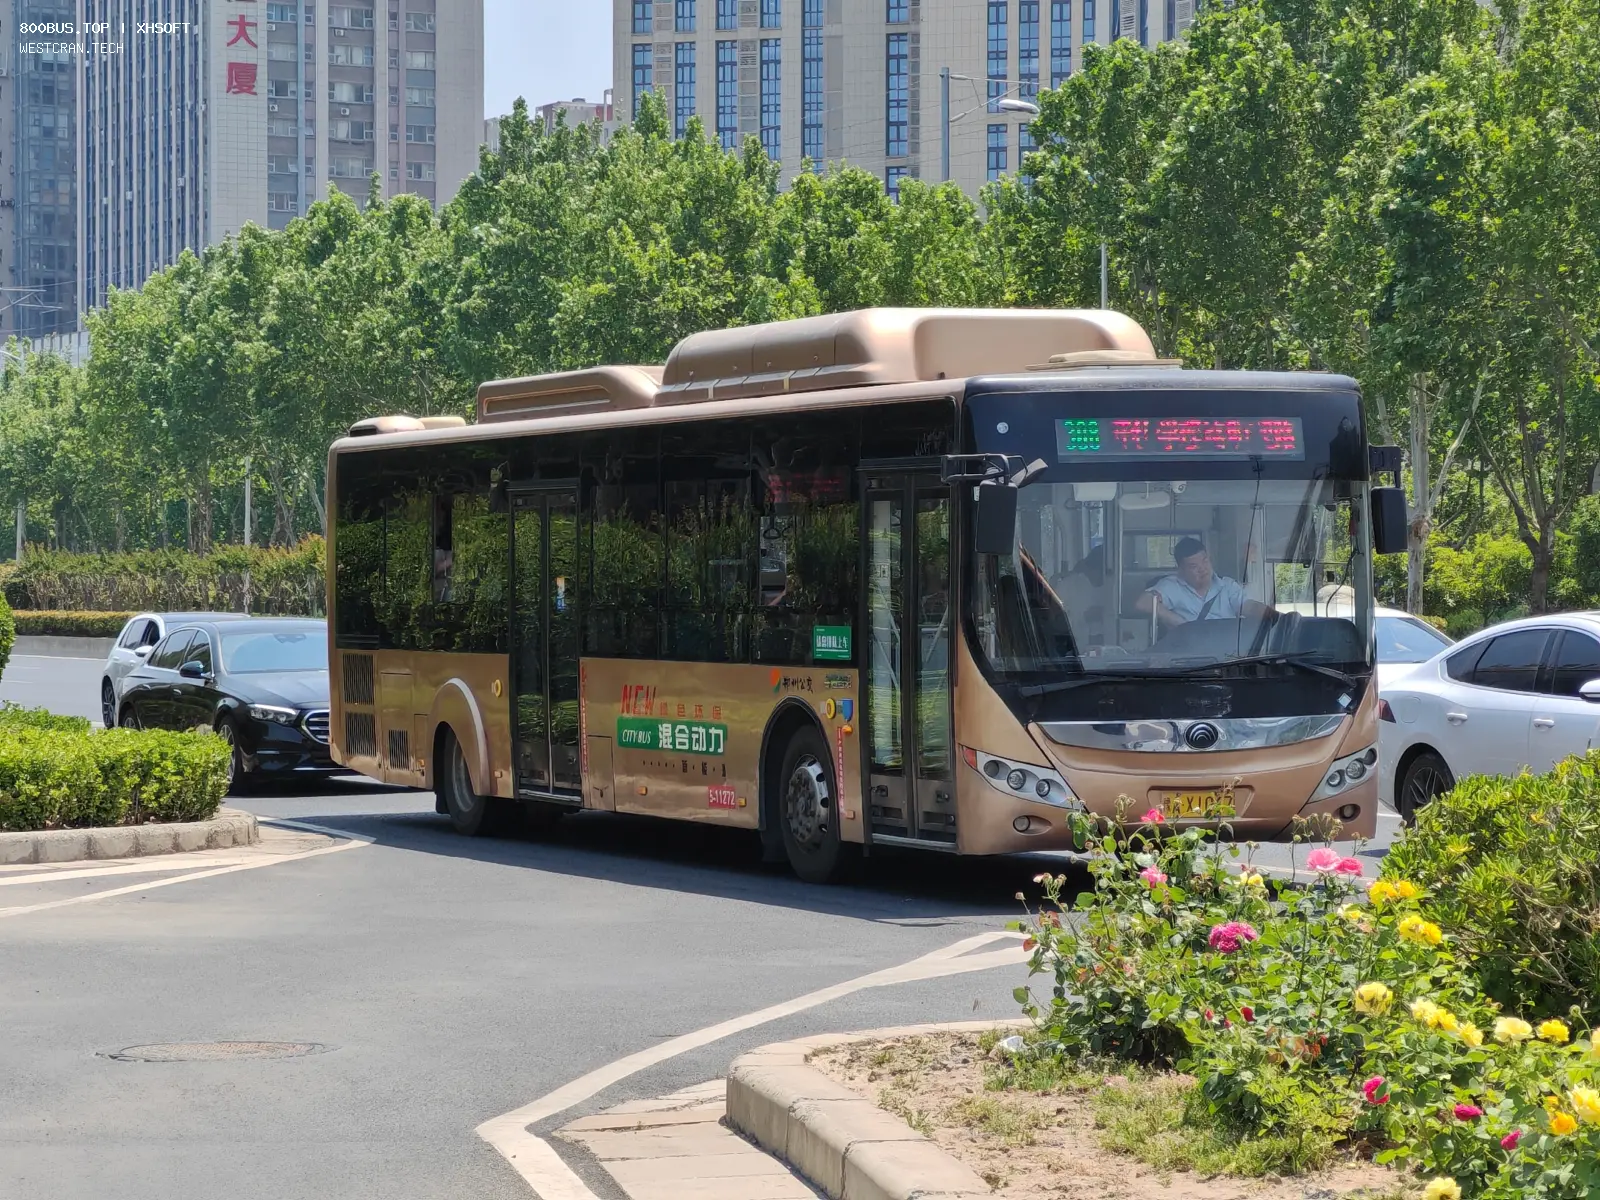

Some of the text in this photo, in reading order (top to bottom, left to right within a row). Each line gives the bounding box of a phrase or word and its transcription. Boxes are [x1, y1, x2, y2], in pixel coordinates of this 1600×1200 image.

[226, 0, 258, 96] 大厦
[620, 684, 657, 716] NEW
[782, 676, 814, 694] 郑州公交
[658, 723, 724, 753] 混合动力
[709, 789, 735, 806] 5-11272
